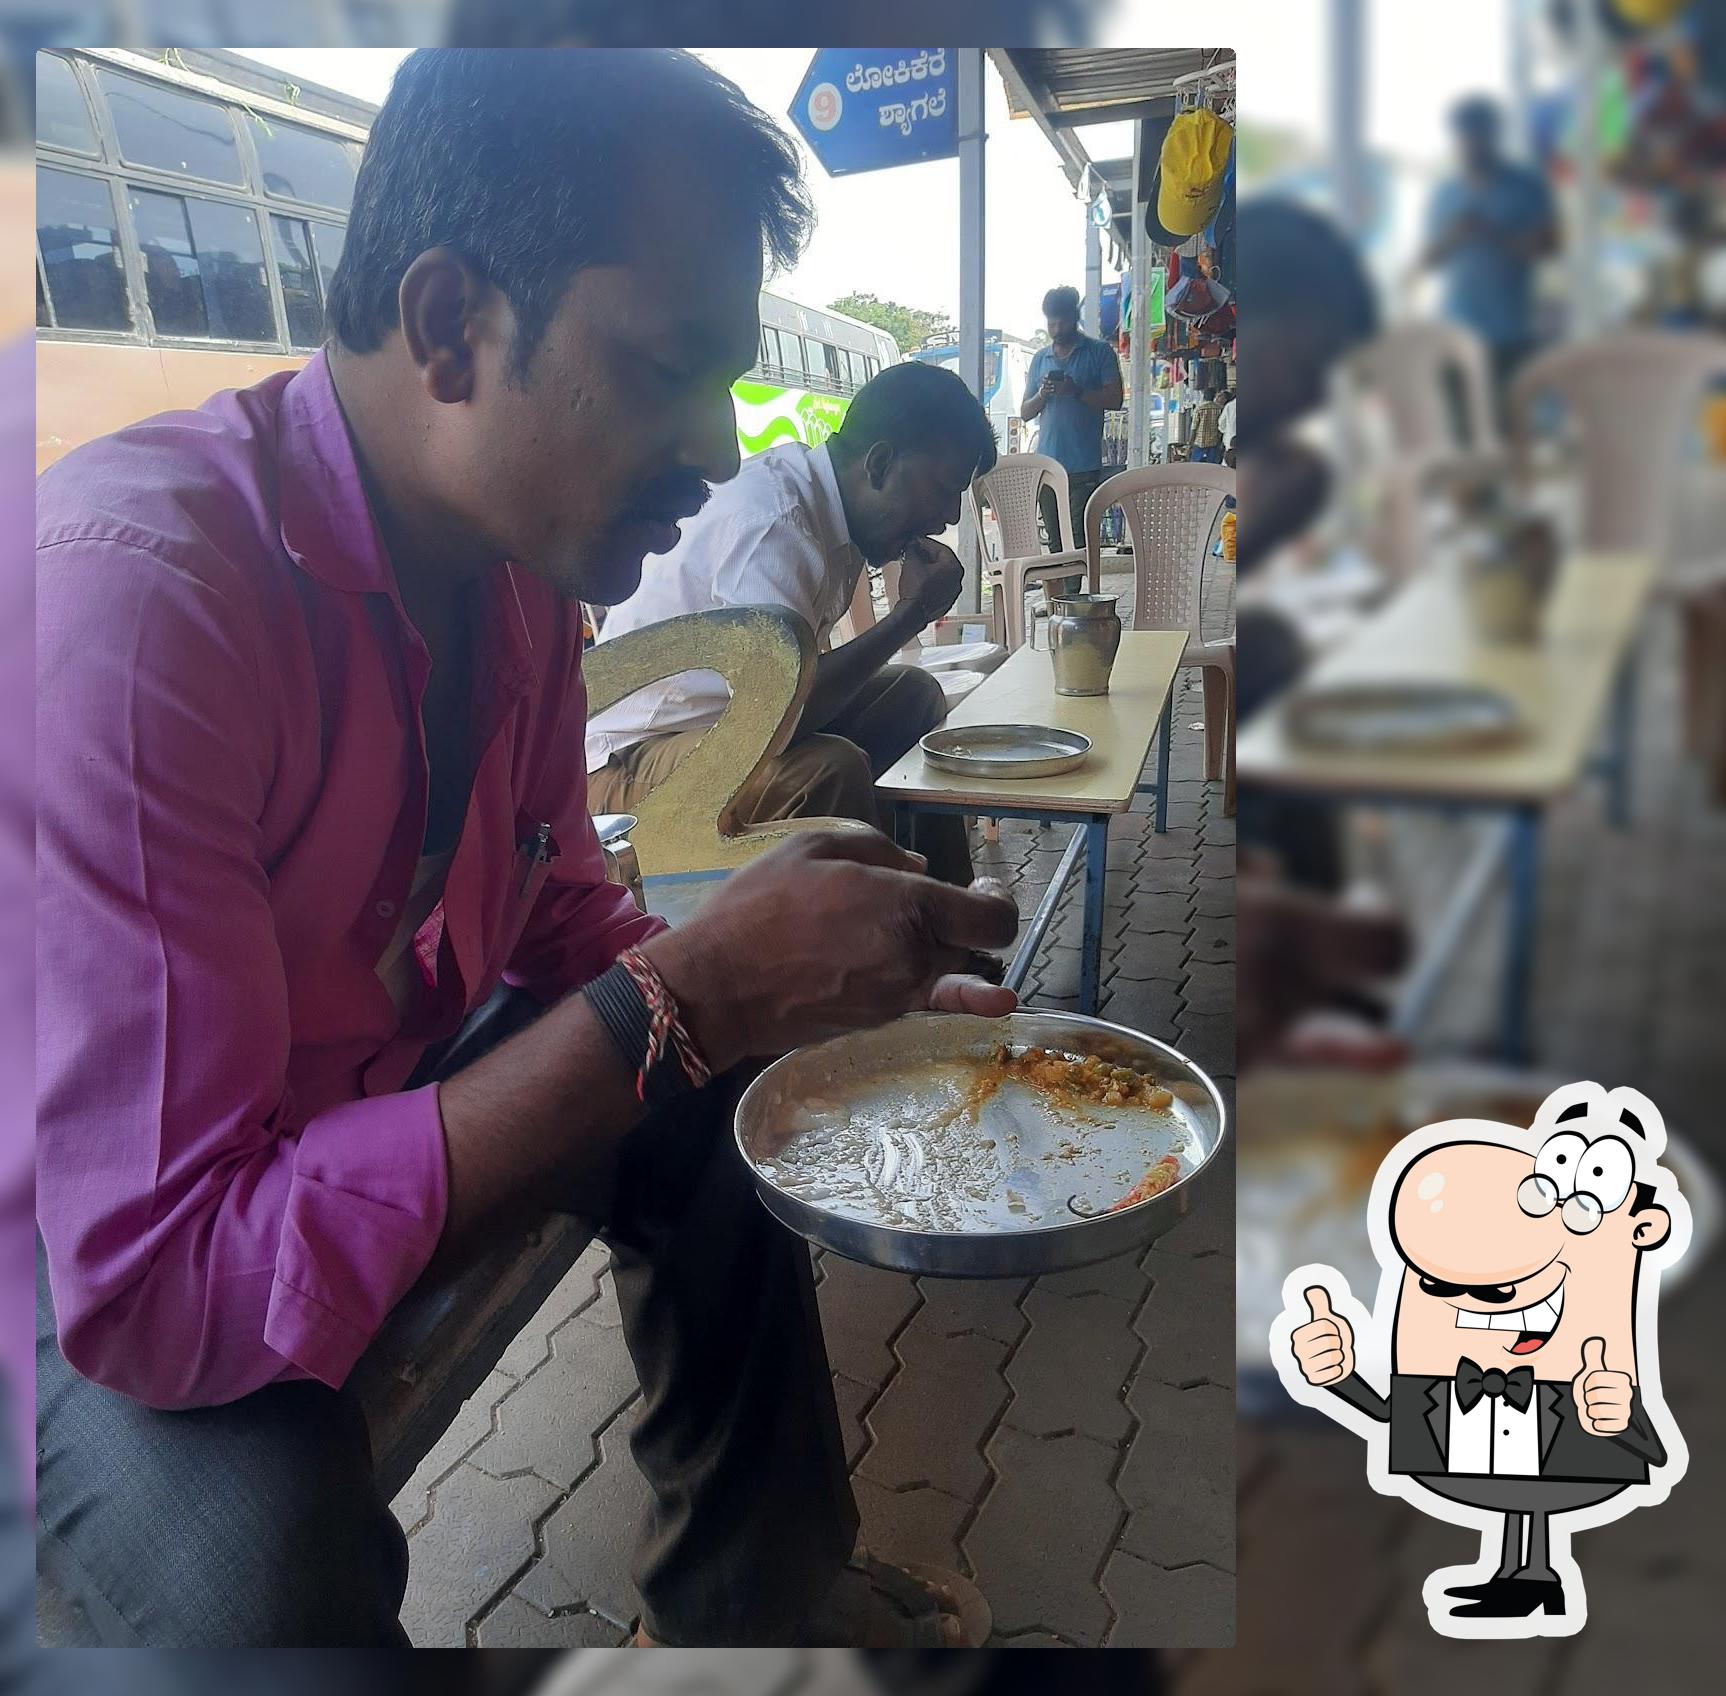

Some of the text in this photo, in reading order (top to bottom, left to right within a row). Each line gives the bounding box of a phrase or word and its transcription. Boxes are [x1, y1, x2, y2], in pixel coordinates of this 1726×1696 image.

[846, 48, 945, 93] ಲೋಕಿಕೆರೆ
[814, 91, 836, 122] 9
[879, 88, 945, 136] ಶ್ಯಾಗಲೆ
